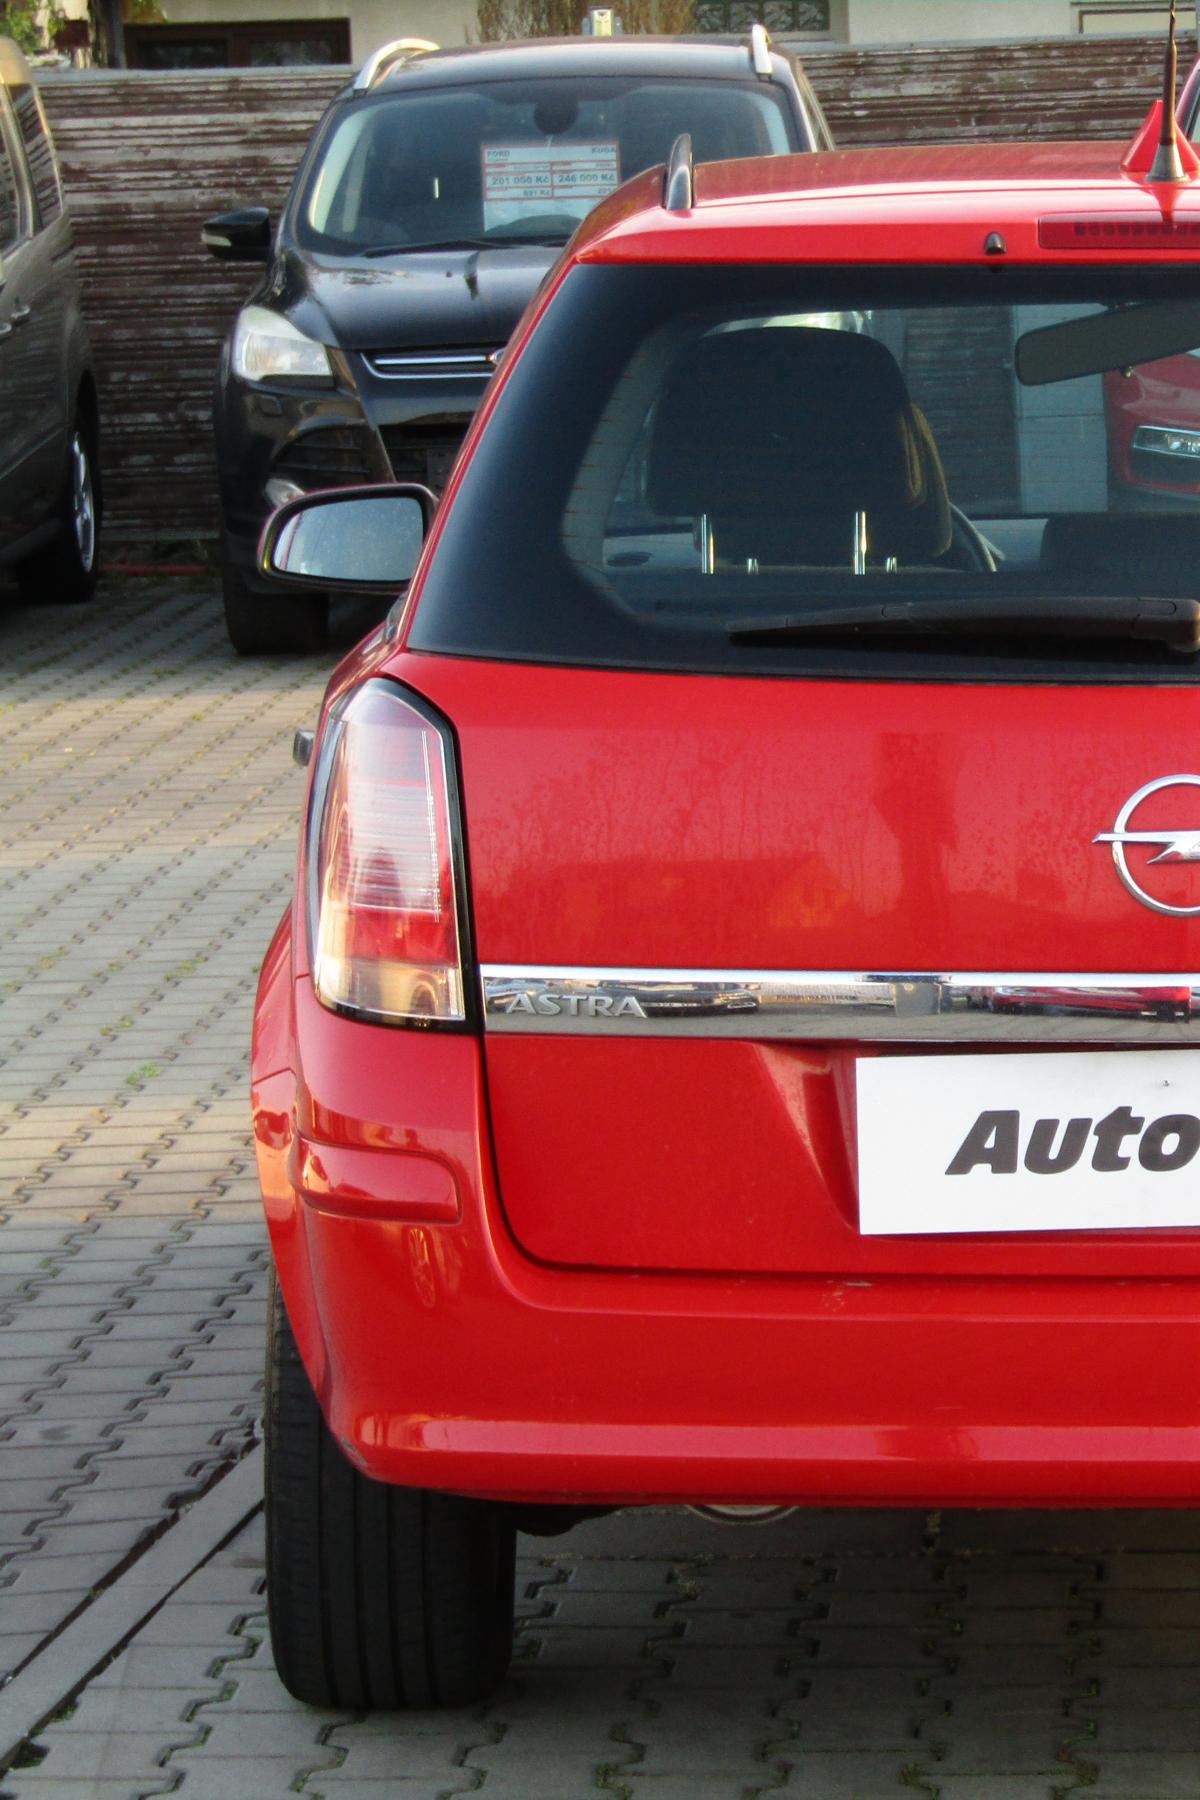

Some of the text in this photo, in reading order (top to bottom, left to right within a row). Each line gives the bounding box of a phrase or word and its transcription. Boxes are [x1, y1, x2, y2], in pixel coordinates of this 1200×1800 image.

[487, 150, 511, 158] FORD
[491, 175, 550, 186] 201 000 Kč
[558, 172, 615, 183] 246 000 Kč
[505, 993, 648, 1018] ASTRA
